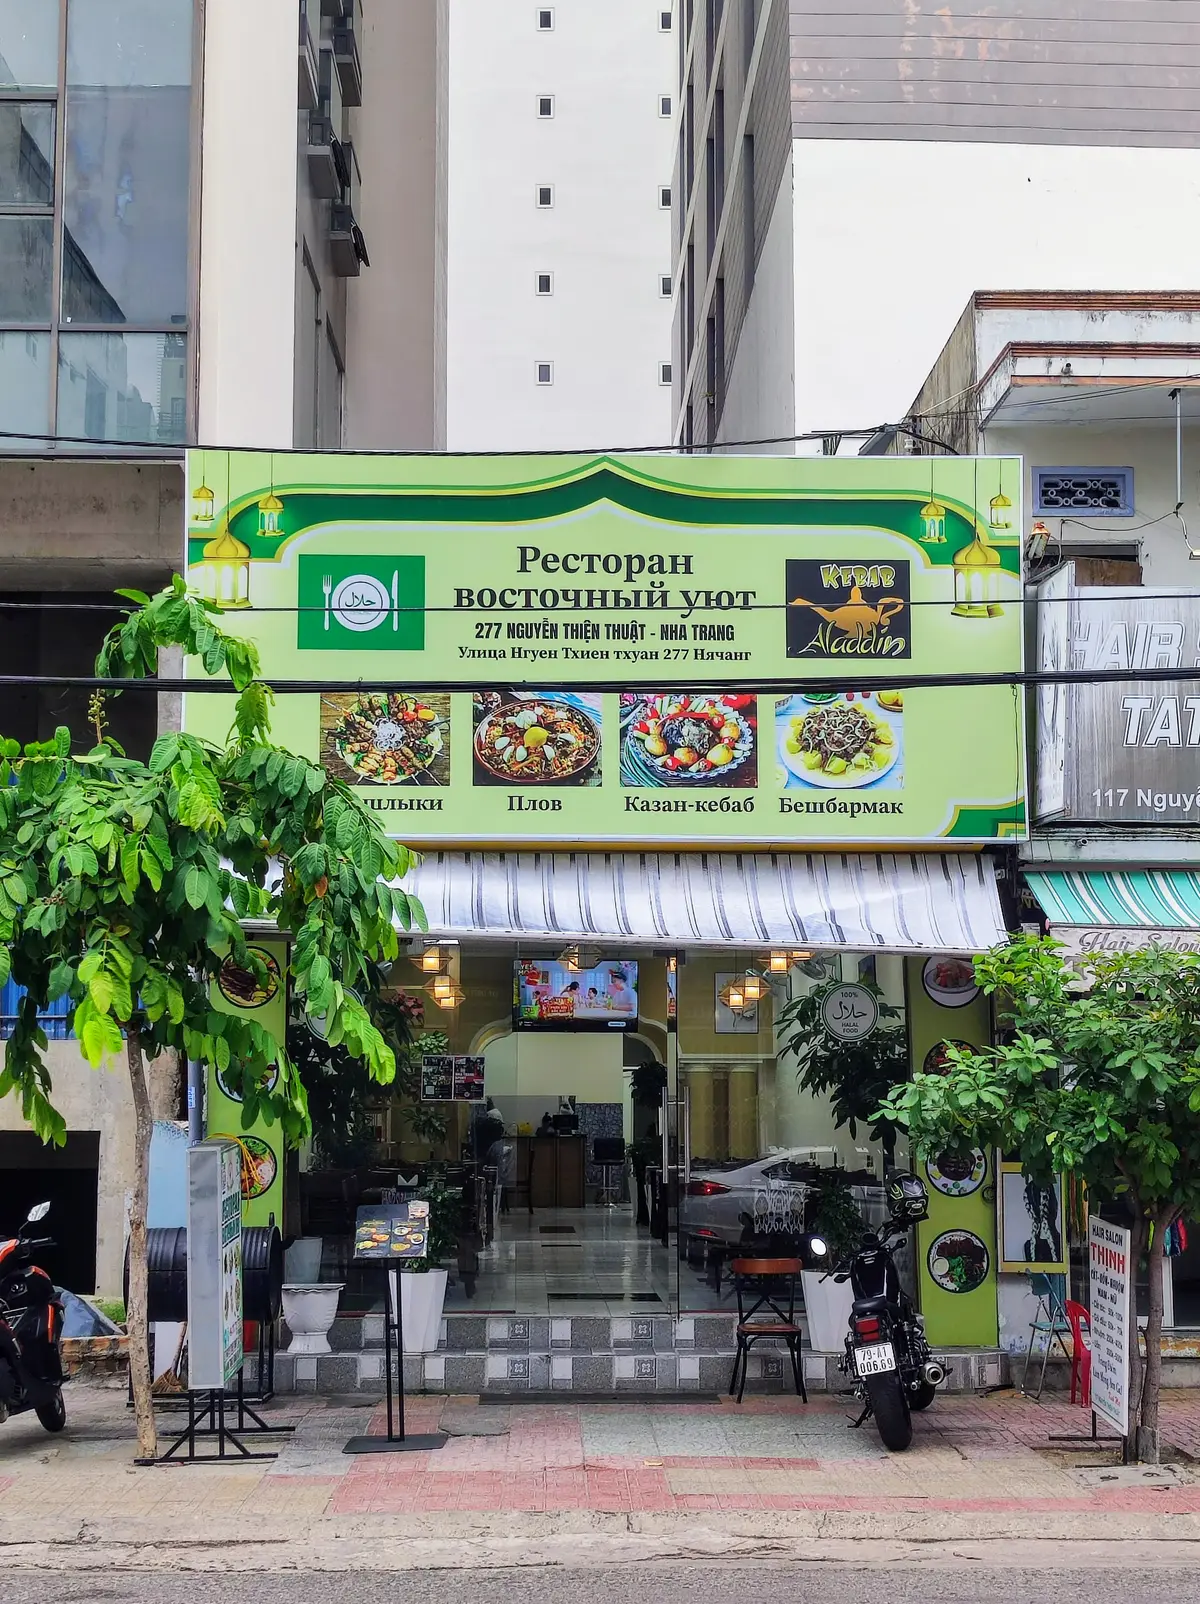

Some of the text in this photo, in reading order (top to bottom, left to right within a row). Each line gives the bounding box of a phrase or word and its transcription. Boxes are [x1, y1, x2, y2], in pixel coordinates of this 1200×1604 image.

[516, 546, 694, 582] Ресторан
[820, 564, 896, 589] KEBAB
[344, 591, 376, 608] حلال
[453, 580, 757, 619] восточный уют
[475, 622, 503, 639] 277
[507, 617, 559, 640] NGUYỄN
[563, 619, 600, 643] THIỆN
[604, 620, 646, 643] THUẬT
[660, 624, 688, 641] NHA
[692, 624, 735, 641] TRANG
[798, 620, 906, 656] Aladdin
[458, 646, 752, 664] Улица Нгуен Тхиен тхуан 277 Нячанг
[1073, 621, 1186, 670] HAIR
[362, 798, 444, 811] шлыки
[507, 795, 563, 811] Плов
[623, 796, 755, 813] Казан-кебаб
[778, 797, 904, 818] Бешбармак
[1092, 788, 1129, 807] 117
[832, 1001, 868, 1020] حلال
[1092, 1224, 1123, 1247] HAIR SALON
[1090, 1241, 1126, 1275] THỊNH
[860, 1358, 893, 1373] 006.69
